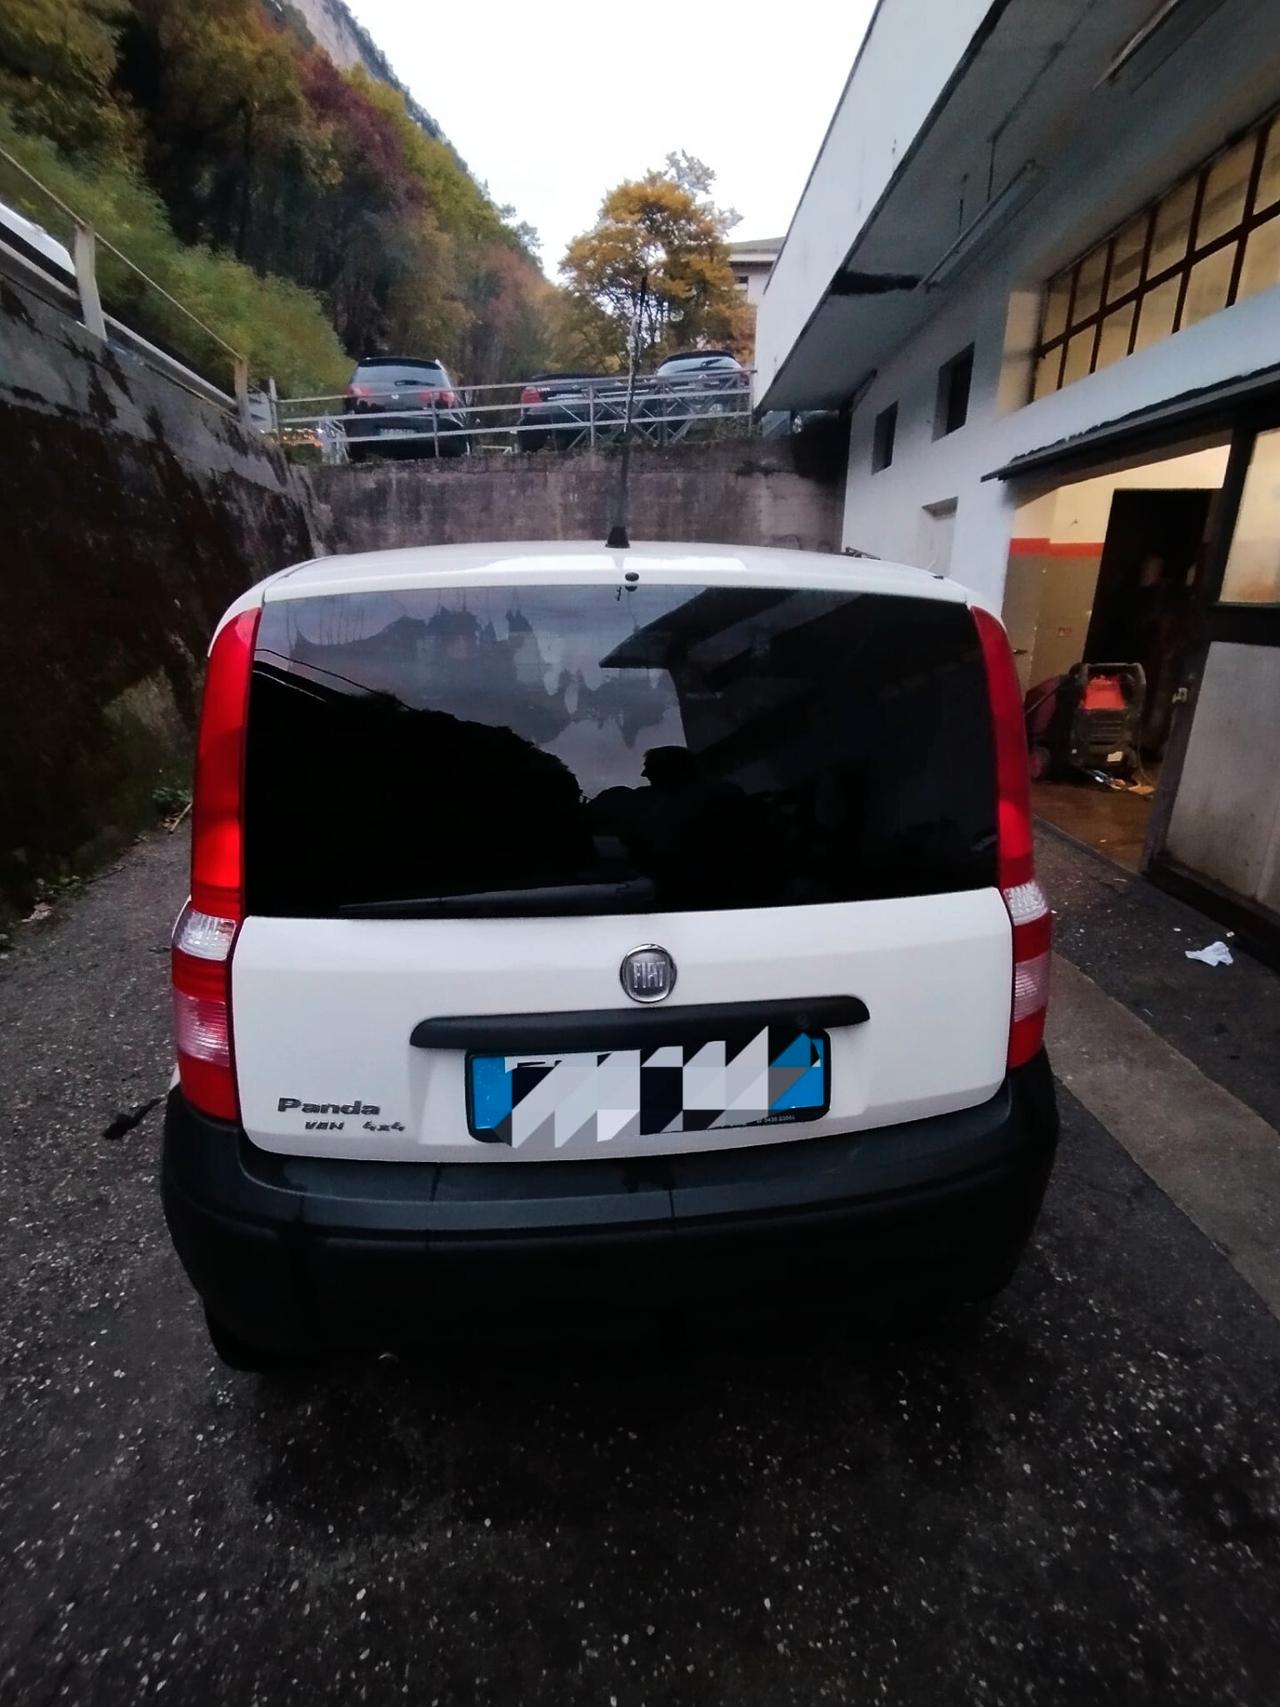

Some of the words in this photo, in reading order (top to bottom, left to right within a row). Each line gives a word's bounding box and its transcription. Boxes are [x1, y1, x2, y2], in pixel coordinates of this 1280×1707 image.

[633, 961, 666, 989] FIAT
[277, 1097, 381, 1116] Panda
[362, 1120, 406, 1132] 4x4
